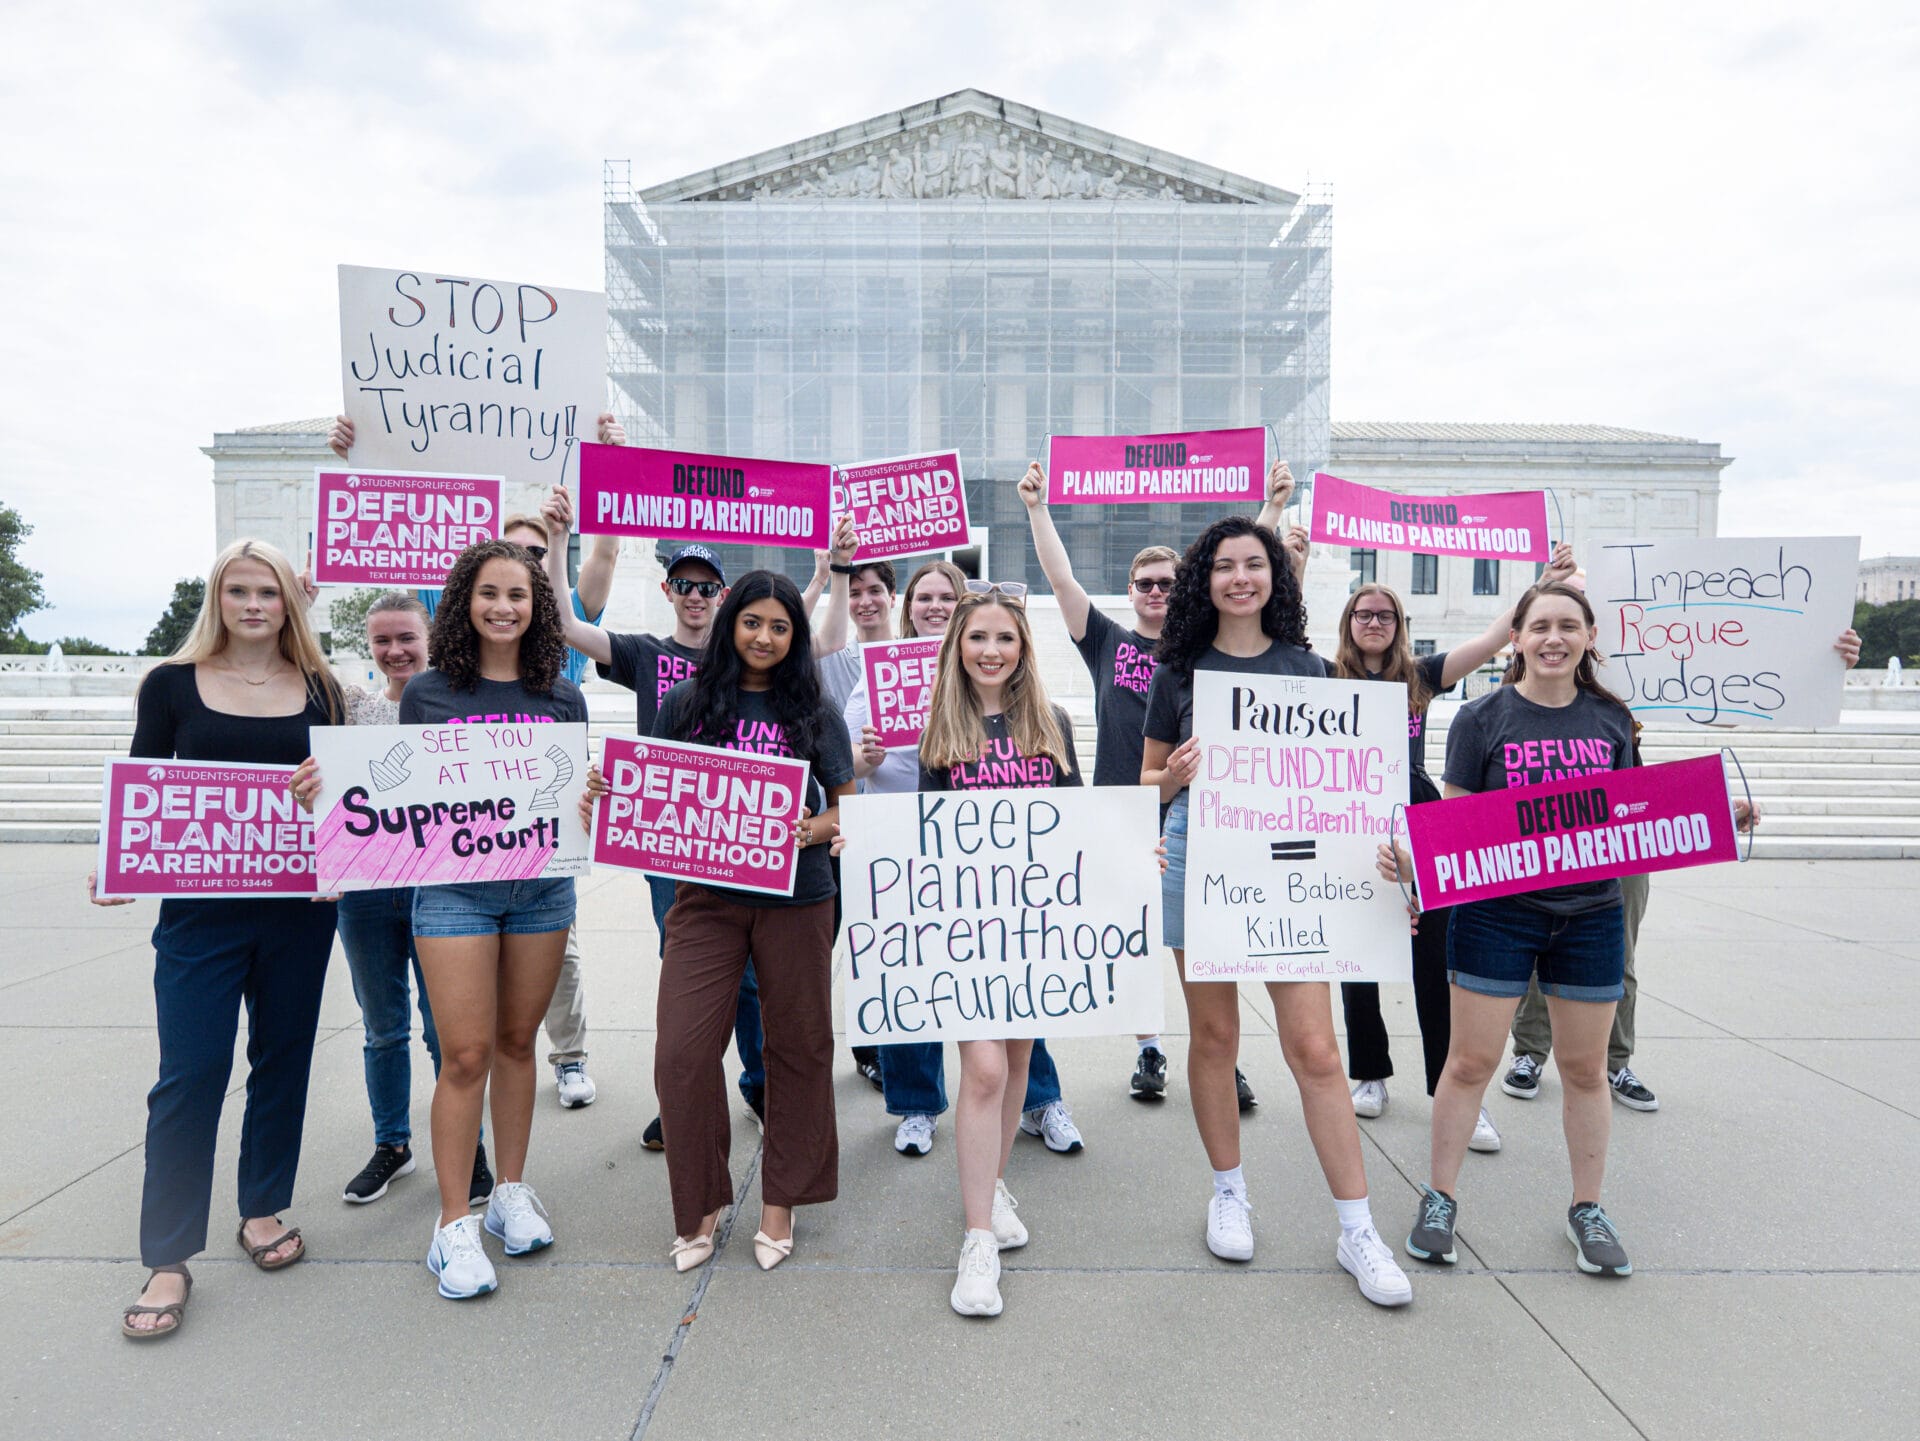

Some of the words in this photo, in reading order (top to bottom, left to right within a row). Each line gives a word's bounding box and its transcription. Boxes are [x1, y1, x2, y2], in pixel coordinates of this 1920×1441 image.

[389, 273, 558, 343] STOP
[351, 332, 543, 390] Judicial
[360, 387, 577, 461] Tyranny!
[850, 459, 938, 479] STUDENTSFORLIFE.ORG
[1125, 442, 1187, 469] DEFUND
[362, 480, 475, 491] STUDENTSFORLIFE.ORG
[673, 464, 744, 498] DEFUND
[832, 469, 955, 511] DEFUND
[1062, 470, 1136, 496] PLANNED
[1138, 466, 1250, 495] PARENTHOOD
[328, 490, 493, 525] DEFUND
[597, 491, 686, 529] PLANNED
[690, 499, 814, 537] PARENTHOOD
[1390, 500, 1459, 526] DEFUND
[857, 517, 962, 546] RENTHOOD
[1326, 511, 1405, 546] PLANNED
[1408, 526, 1532, 553] PARENTHOOD
[326, 549, 456, 570] PARENTHO
[870, 547, 885, 555] TEXT
[885, 545, 899, 553] LIFE
[369, 571, 387, 580] TEXT
[390, 572, 407, 580] LIFE
[1602, 544, 1812, 612] Impeach
[1619, 603, 1749, 661] Rogue
[657, 654, 697, 680] DEF
[874, 656, 938, 690] DEF
[1115, 661, 1156, 680] PLAN
[1280, 679, 1307, 694] THE
[1609, 653, 1785, 724] Judges
[1232, 686, 1362, 738] Paused
[422, 728, 470, 754] SEE
[485, 727, 533, 749] YOU
[1504, 738, 1612, 770] DEFUND
[168, 769, 291, 784] STUDENTSFORLIFE.O
[438, 762, 470, 785] AT
[484, 757, 541, 781] THE
[650, 749, 775, 777] STUDENTSFORLIFE.ORG
[950, 757, 1054, 789] PLANNED
[1208, 744, 1384, 795] DEFUNDING
[1387, 759, 1402, 775] of
[611, 759, 793, 818] DEFUND
[343, 786, 516, 848] Supreme
[608, 795, 789, 848] PLANNED
[1515, 787, 1609, 837] DEFUND
[451, 817, 559, 857] Court!
[606, 826, 785, 871] PARENTHOOD
[1434, 839, 1541, 894] PLANNED
[1545, 812, 1713, 873] PARENTHOOD
[176, 879, 199, 888] TEXT
[202, 879, 223, 888] LIFE
[226, 879, 239, 888] TO
[242, 879, 273, 888] 53445
[650, 858, 671, 868] TEXT
[672, 861, 691, 871] LIFE
[692, 864, 705, 873] TO
[706, 866, 734, 878] 53445
[869, 850, 1083, 920] Planned
[1204, 873, 1266, 905] More
[1288, 872, 1374, 903] Babies
[1247, 914, 1330, 948] Killed
[857, 962, 1115, 1035] defunded!
